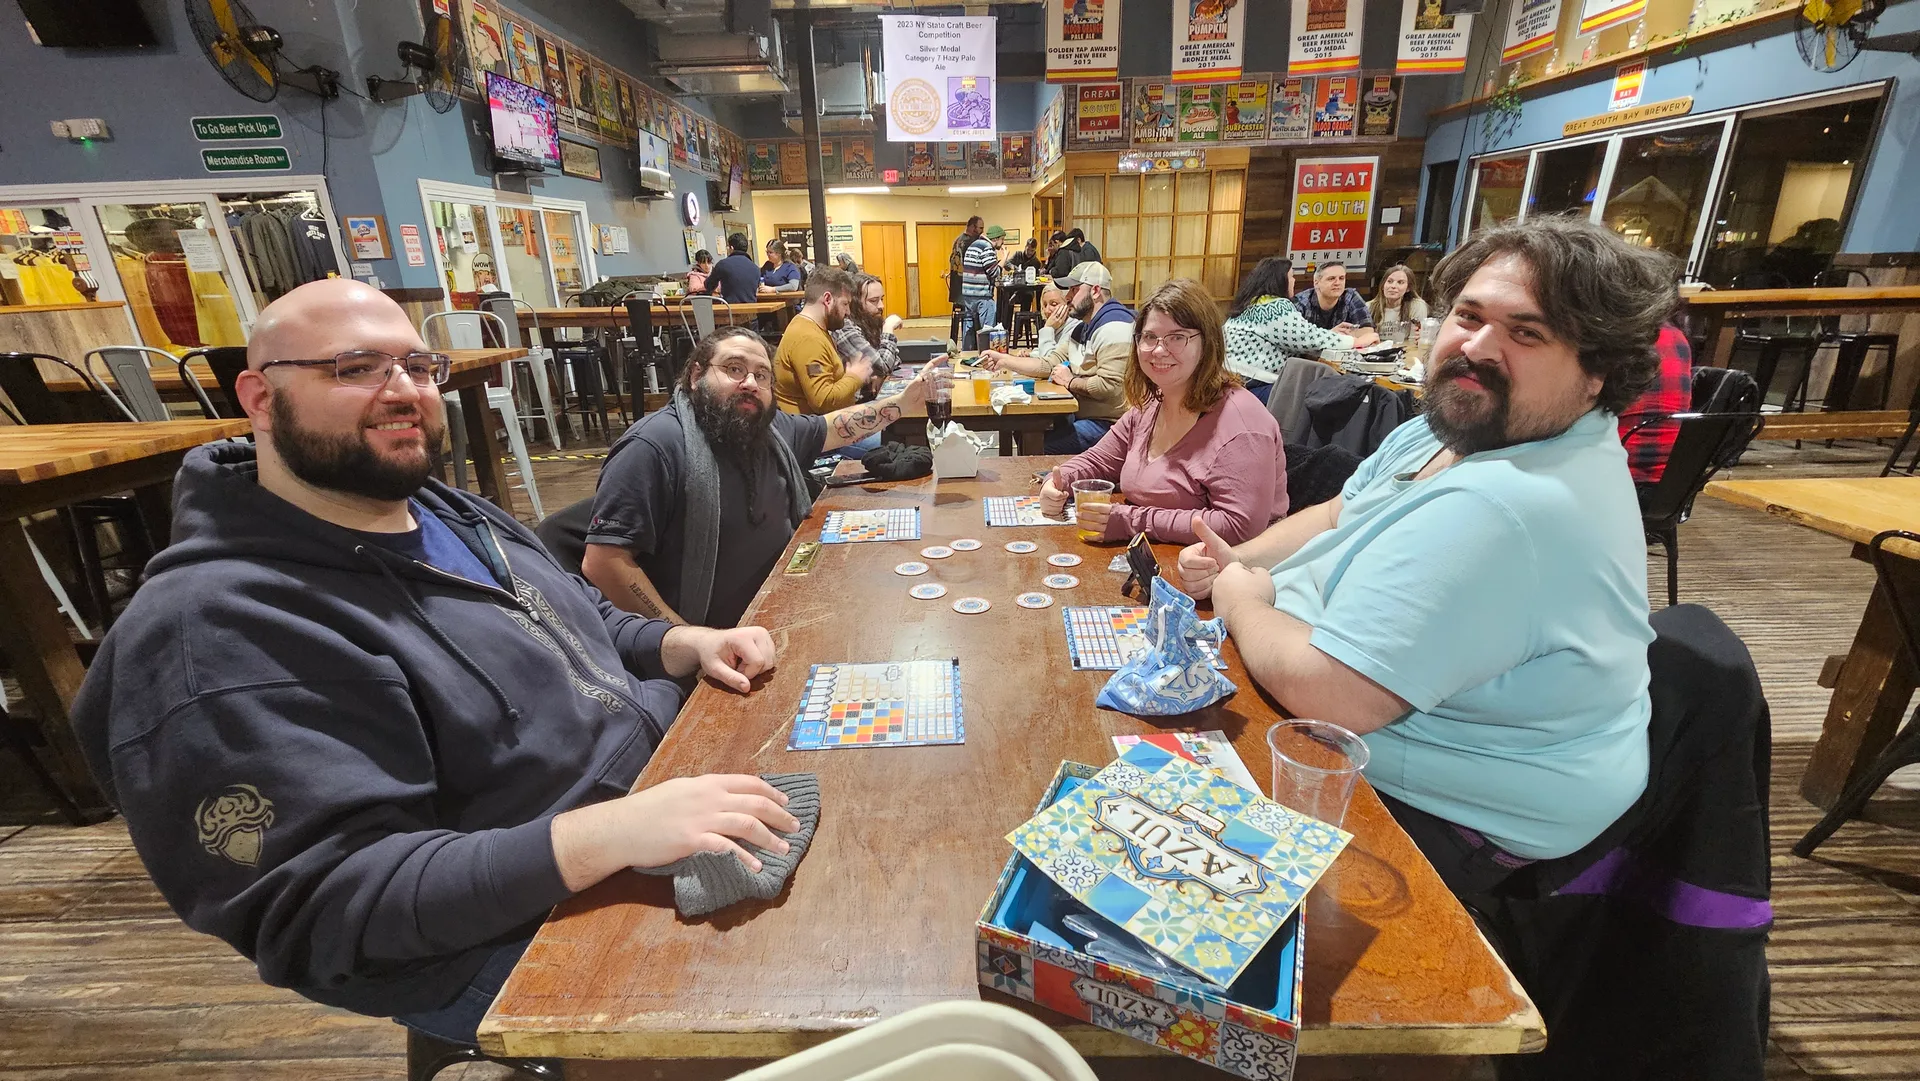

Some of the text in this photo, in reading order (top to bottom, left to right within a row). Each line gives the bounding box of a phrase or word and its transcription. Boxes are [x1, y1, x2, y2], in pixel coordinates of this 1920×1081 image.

[1529, 4, 1556, 19] AMERICAN
[897, 20, 914, 28] 2023
[927, 21, 945, 29] State
[1528, 13, 1550, 26] FESTIVAL
[1189, 22, 1227, 35] PUMPKIN
[1530, 21, 1548, 31] MEDAL
[918, 31, 961, 39] Competition
[1320, 38, 1347, 46] FESTIVAL
[904, 54, 935, 62] Category
[1083, 90, 1116, 99] GREAT
[1083, 103, 1116, 113] SOUTH
[1565, 101, 1688, 132] GREAT SOUTH BAY BREWERY
[197, 124, 207, 134] To
[208, 123, 219, 134] Go
[219, 123, 237, 134] Beer
[238, 122, 256, 133] Pick
[256, 122, 268, 134] Up
[1090, 119, 1109, 127] BAY
[1225, 123, 1264, 131] SURFCASTER
[1315, 121, 1352, 131] BLOOD ORANGE
[1134, 127, 1174, 138] AMBITION
[206, 155, 254, 165] Merchandise
[254, 154, 276, 164] Room
[846, 171, 873, 179] MASSIVE
[908, 169, 935, 177] PUMPKIN
[1302, 171, 1369, 188] GREAT
[1298, 200, 1365, 216] SOUTH
[1309, 228, 1348, 244] BAY
[1289, 250, 1364, 260] BREWERY
[629, 582, 663, 618] REMEMBER
[1127, 809, 1238, 878] AZUL
[1089, 984, 1159, 1018] AZUL
